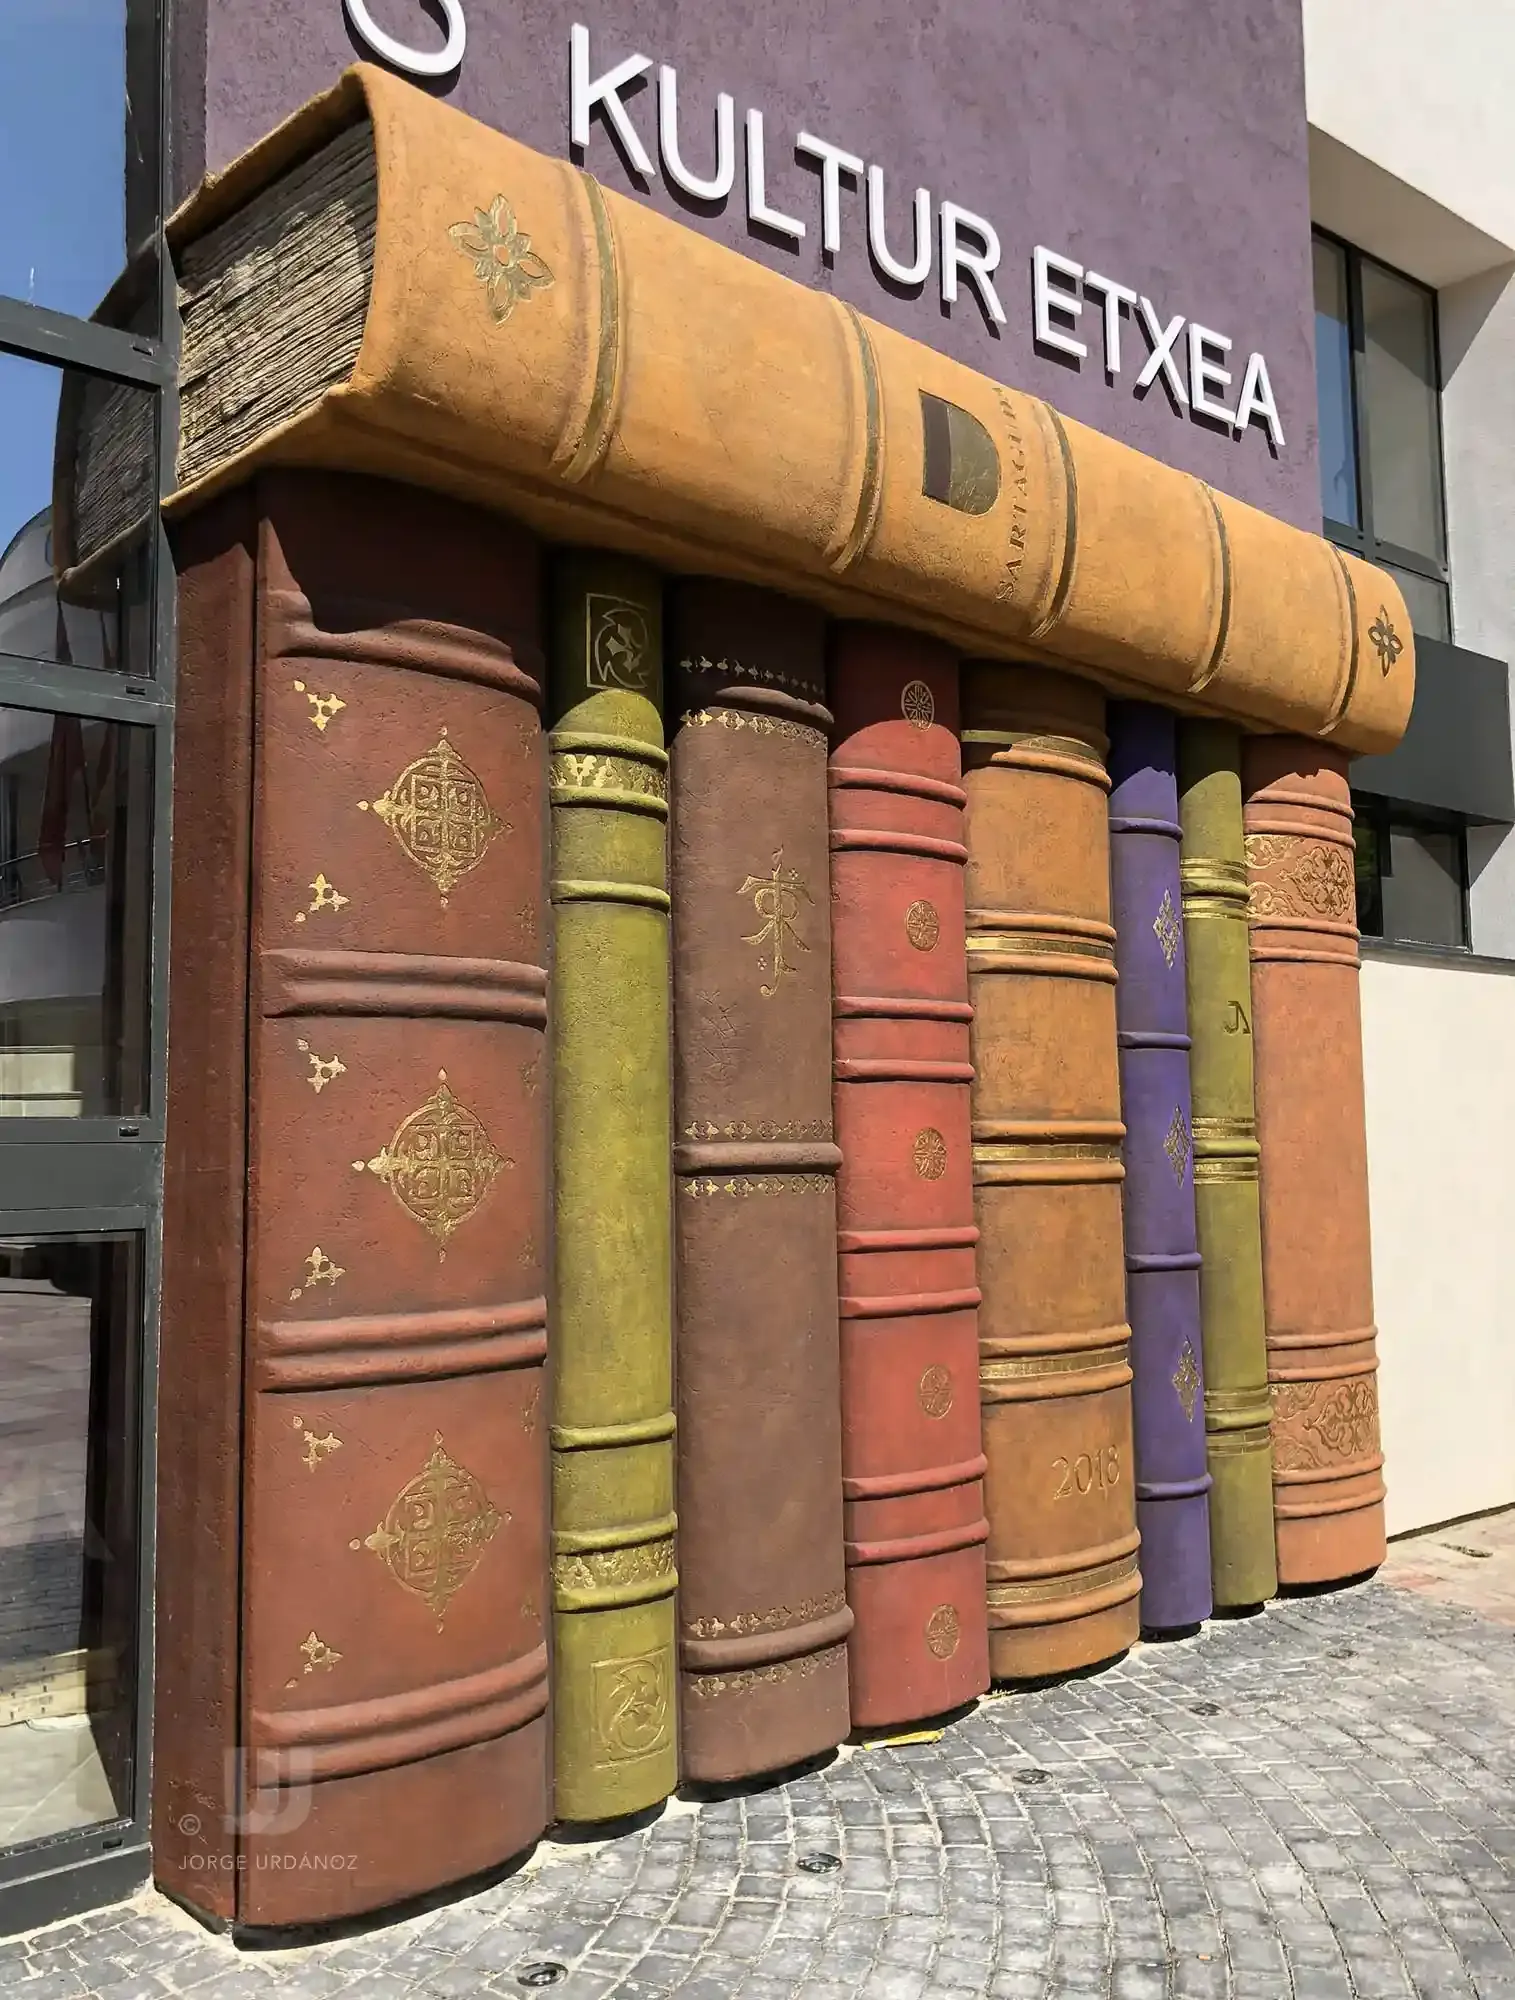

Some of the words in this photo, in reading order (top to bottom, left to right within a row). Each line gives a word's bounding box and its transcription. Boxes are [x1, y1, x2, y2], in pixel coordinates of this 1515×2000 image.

[570, 23, 1007, 325] KULTUR
[1033, 245, 1285, 447] ETXEA
[1051, 1444, 1120, 1500] 2018
